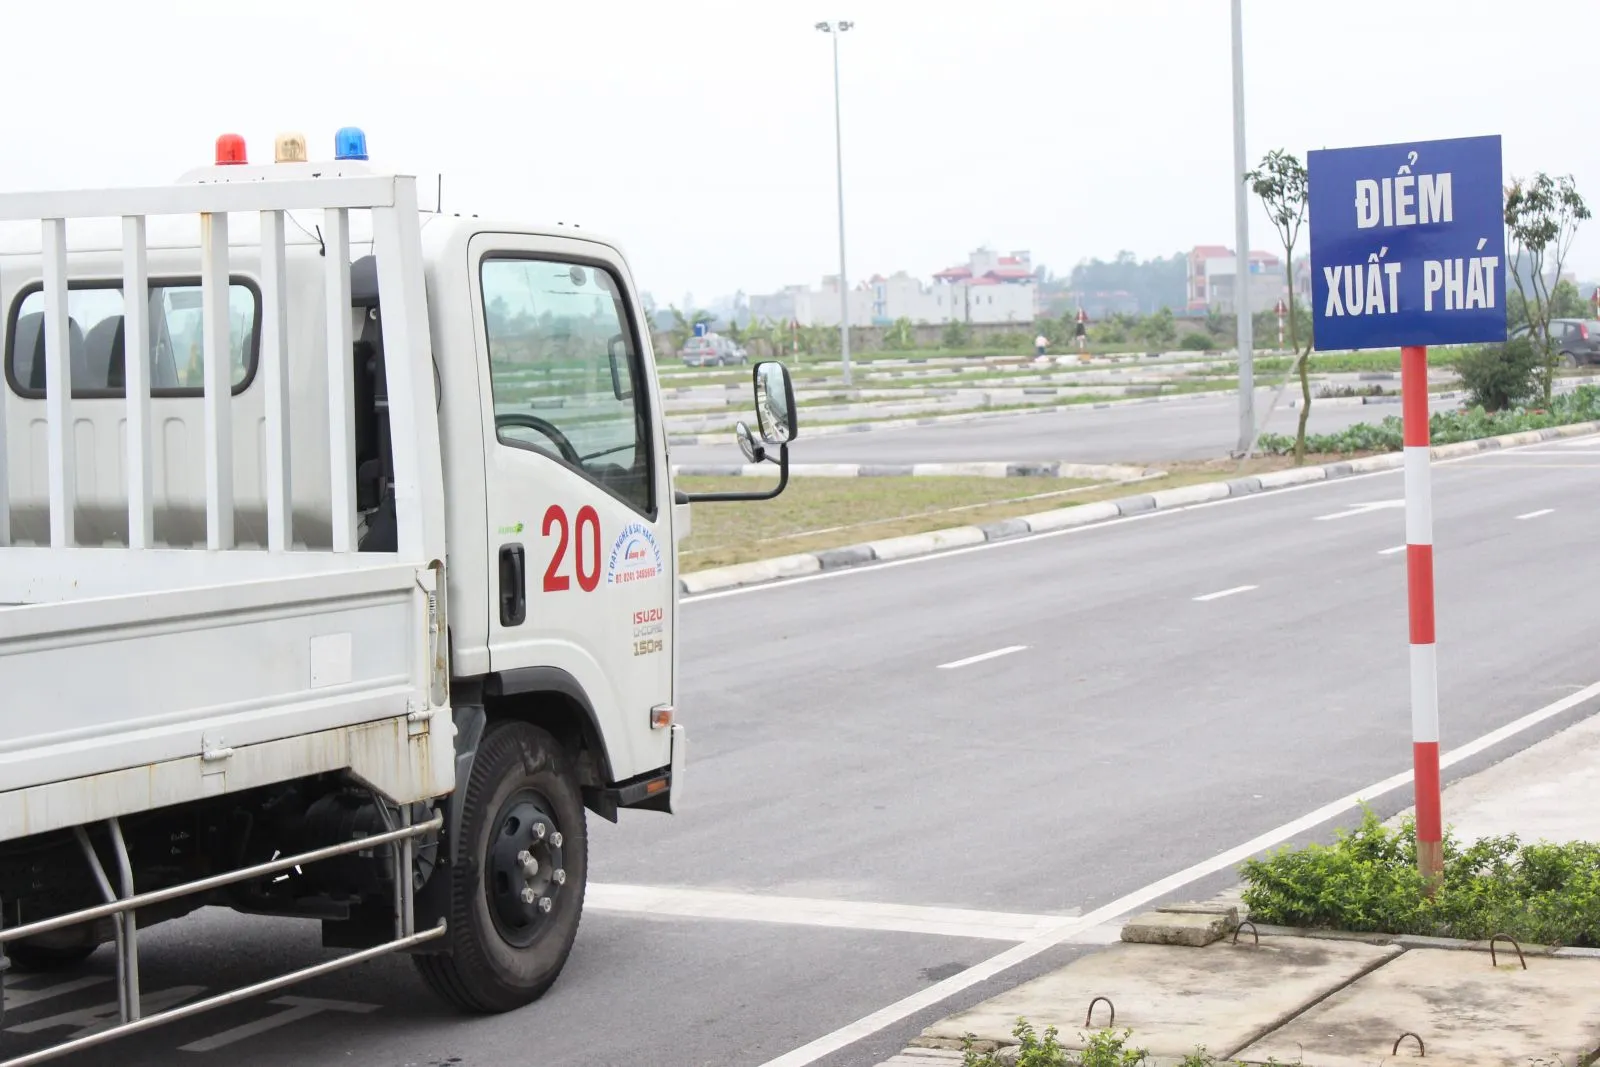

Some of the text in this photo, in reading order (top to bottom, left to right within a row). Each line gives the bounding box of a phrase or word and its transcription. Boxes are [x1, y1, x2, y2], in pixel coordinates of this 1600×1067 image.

[1354, 151, 1453, 229] ĐIỂM
[1323, 237, 1499, 317] XUẤT PHÁT
[542, 504, 602, 592] 20
[633, 608, 663, 624] ISUZU
